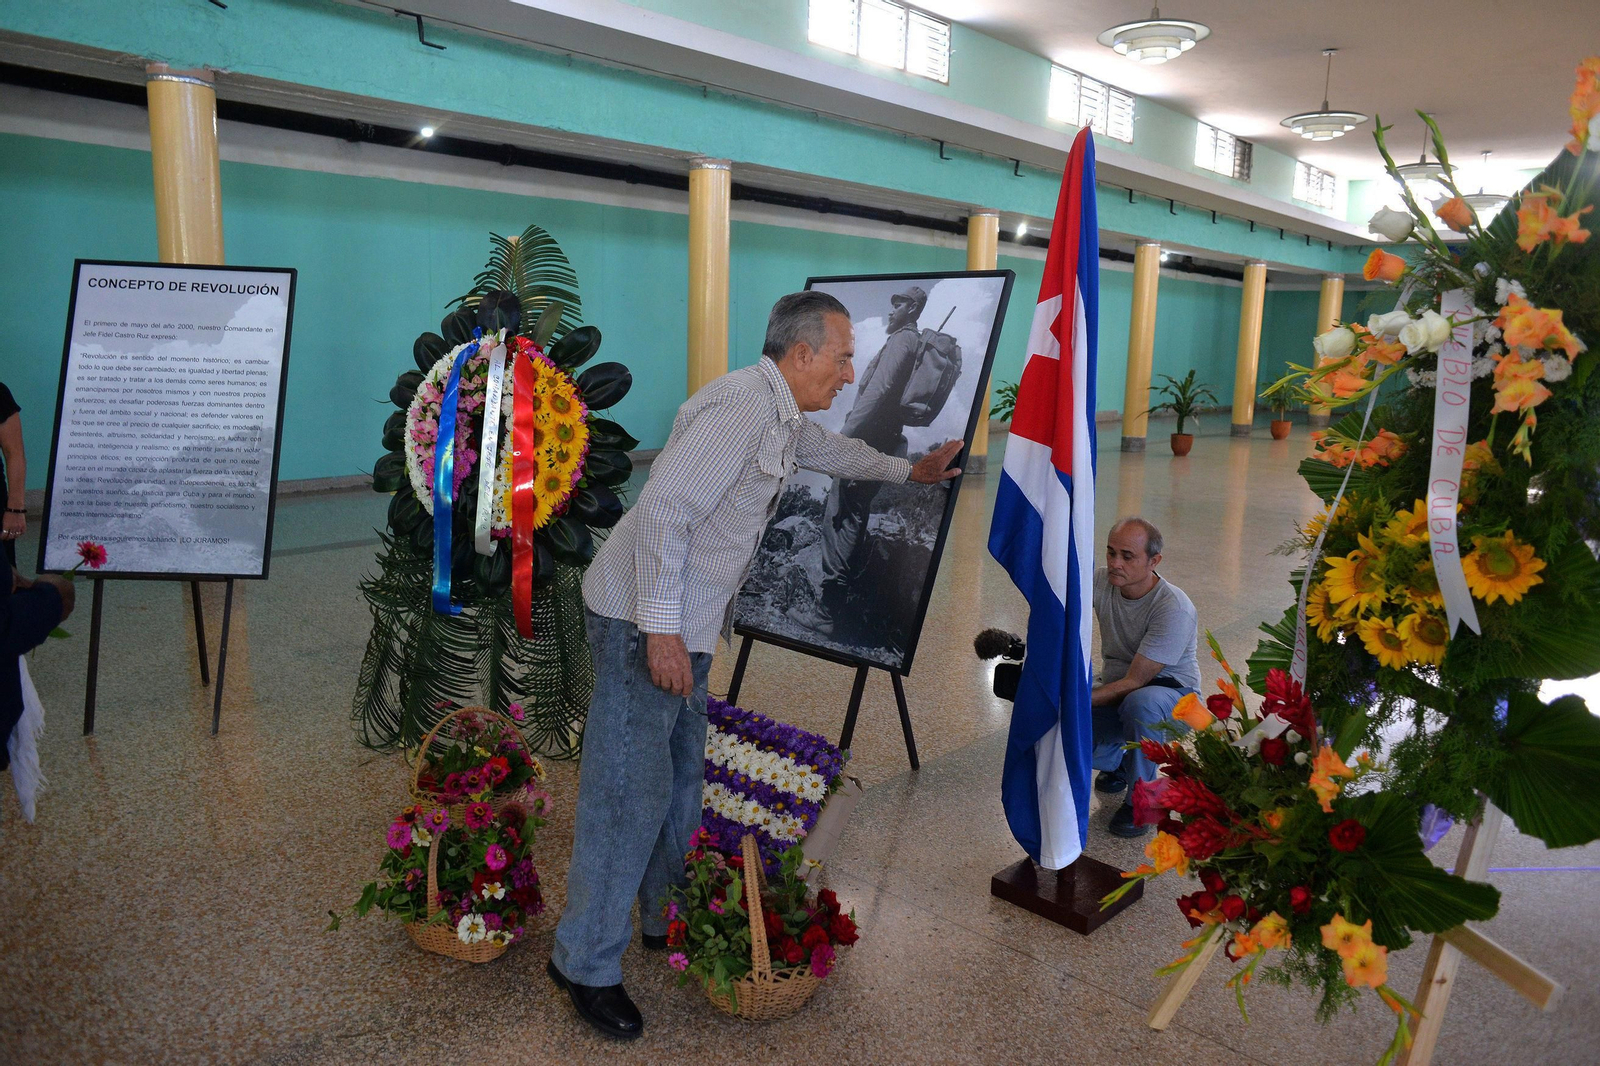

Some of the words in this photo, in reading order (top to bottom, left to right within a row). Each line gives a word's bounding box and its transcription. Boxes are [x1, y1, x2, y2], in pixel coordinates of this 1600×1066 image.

[88, 277, 164, 290] CONCEPTO
[168, 281, 186, 291] DE
[190, 280, 279, 295] REVOLUCIÓN
[92, 320, 117, 328] primero
[223, 324, 262, 332] Comandante
[114, 331, 135, 339] Castro
[187, 367, 214, 376] igualdad
[242, 391, 265, 399] propios
[146, 399, 179, 408] poderosas
[200, 411, 228, 419] defender
[230, 412, 253, 420] valores
[129, 421, 149, 429] precio
[161, 421, 189, 430] cualquier
[1436, 425, 1466, 457] DE
